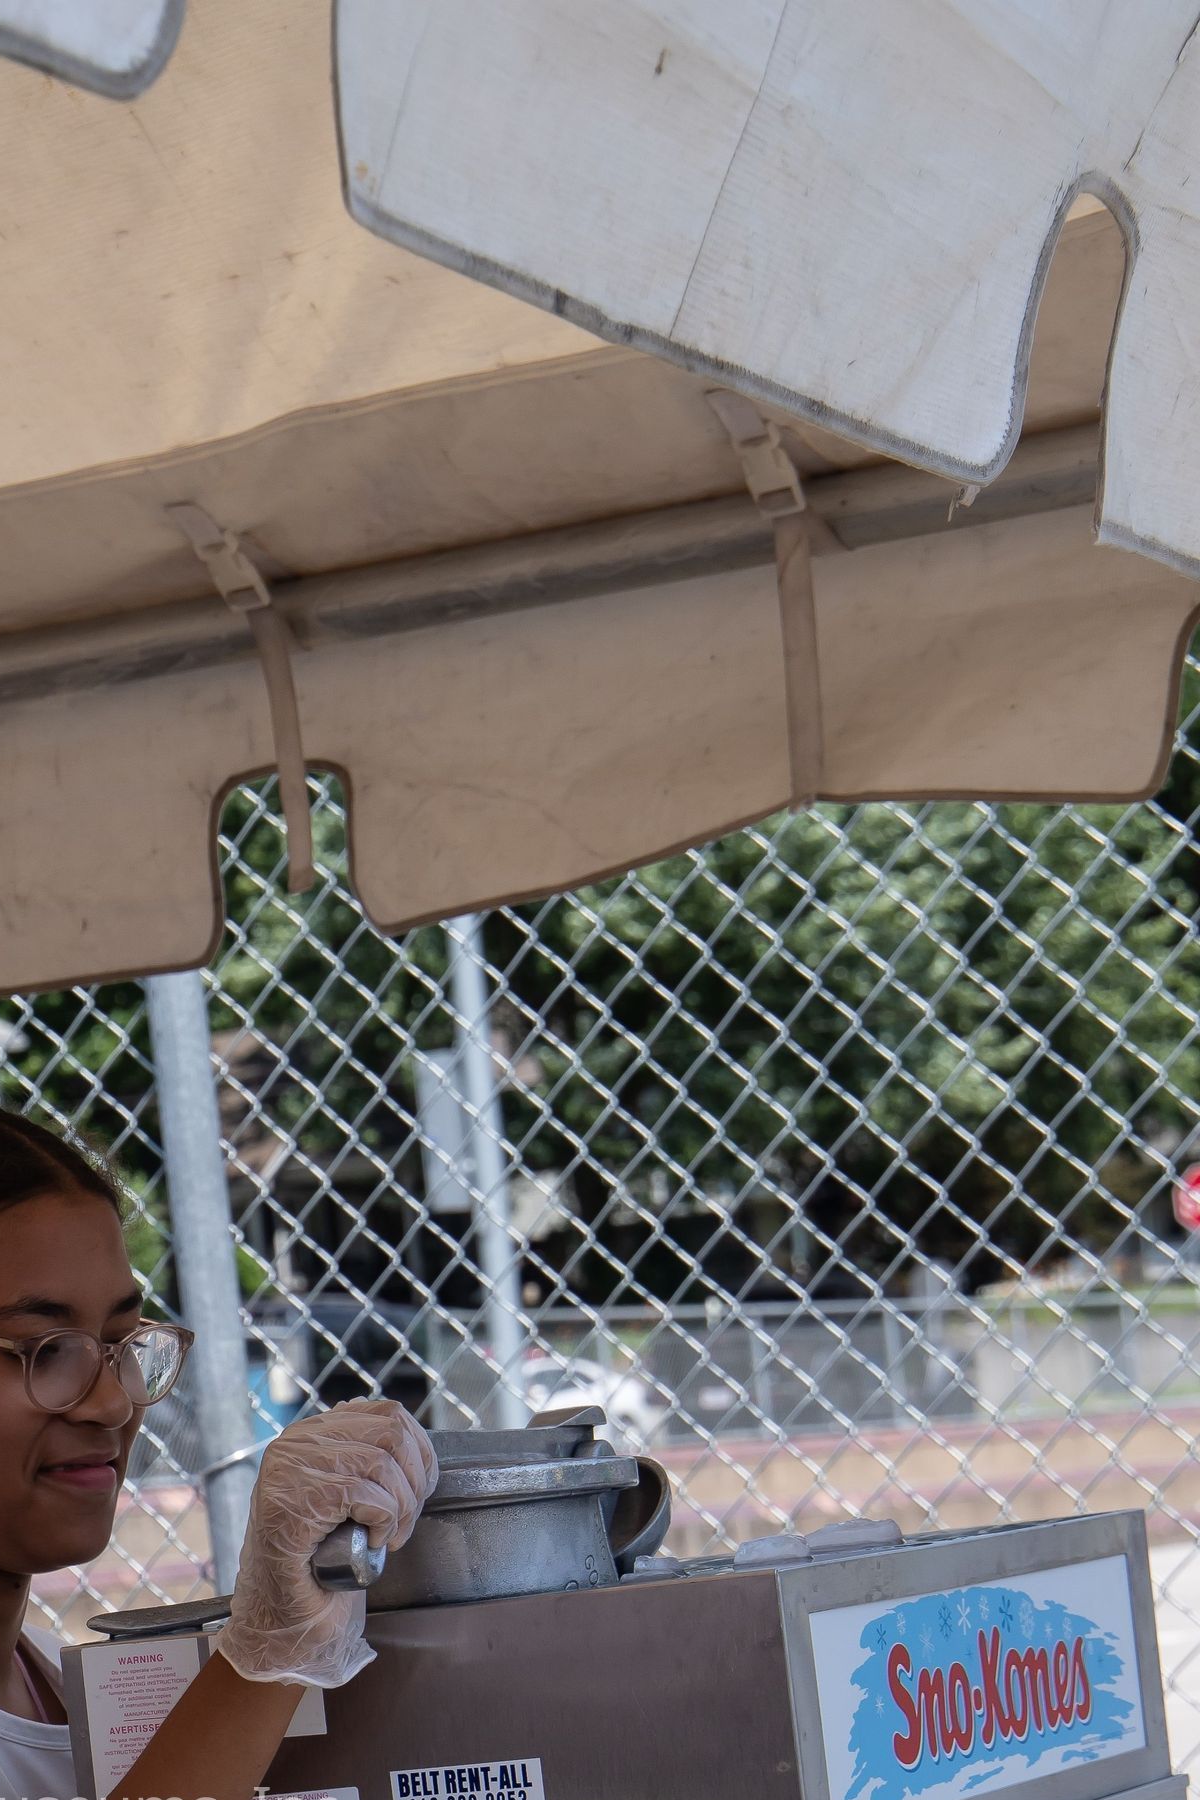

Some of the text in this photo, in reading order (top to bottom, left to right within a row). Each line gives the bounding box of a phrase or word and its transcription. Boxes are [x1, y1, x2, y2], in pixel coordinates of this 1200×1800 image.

[117, 1653, 164, 1666] WARNING
[114, 1681, 146, 1689] OPERATING
[147, 1677, 188, 1686] INSTRUCTIONS
[109, 1723, 160, 1735] AVERTISSE
[397, 1763, 533, 1797] BELT RENT-ALL
